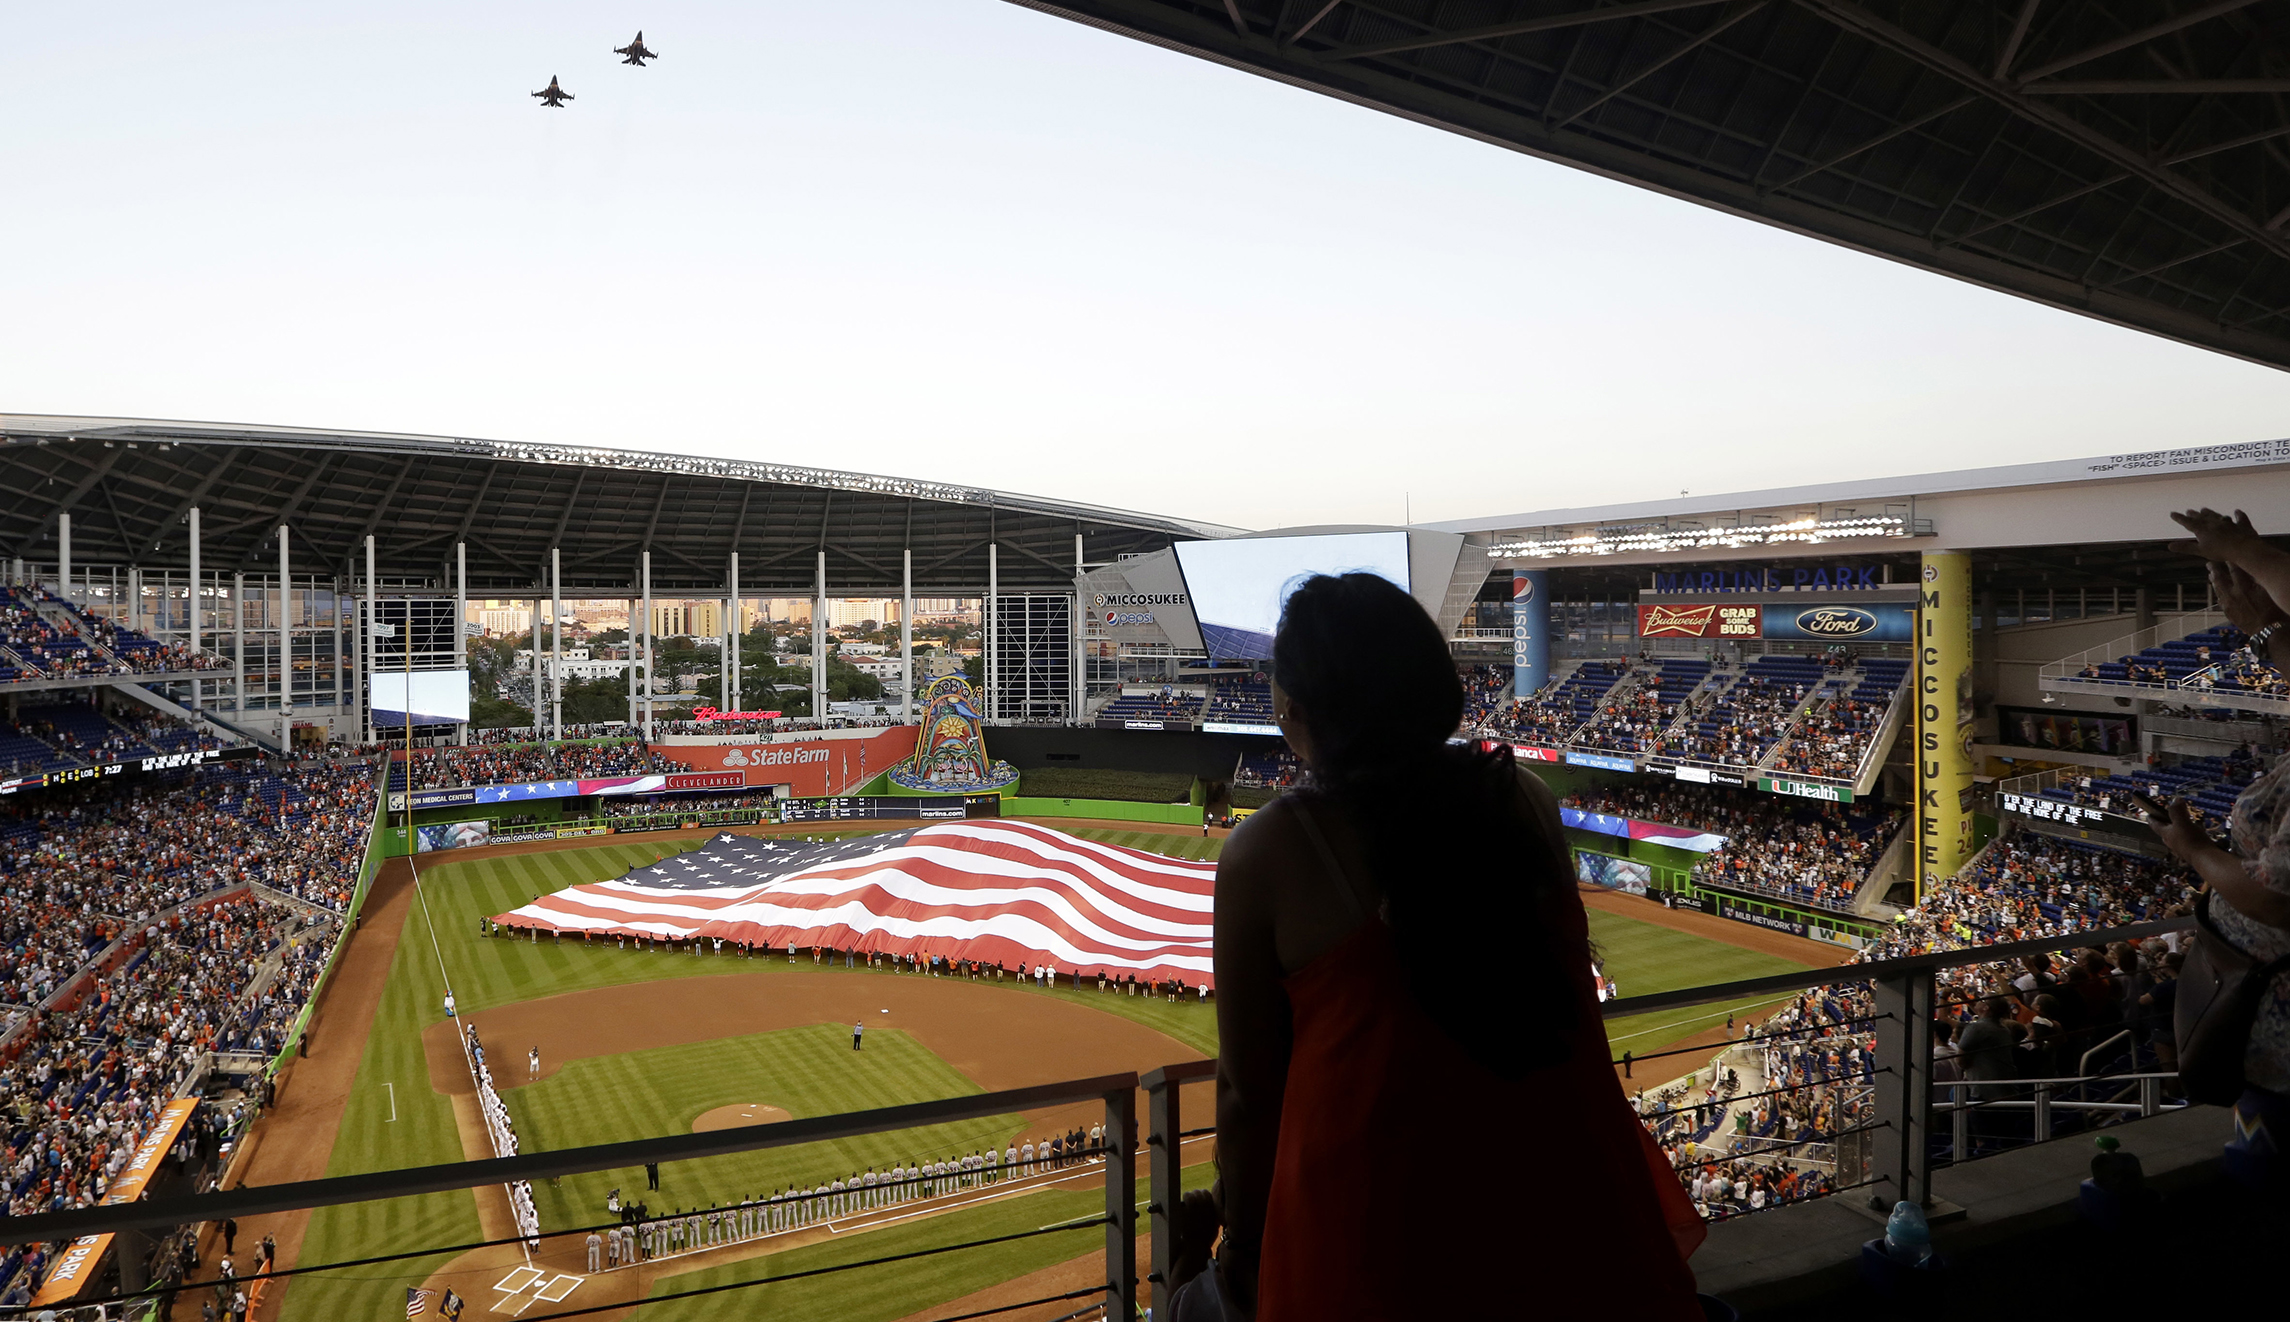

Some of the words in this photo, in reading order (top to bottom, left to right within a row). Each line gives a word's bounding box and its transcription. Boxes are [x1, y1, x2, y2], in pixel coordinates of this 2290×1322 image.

[2126, 452, 2167, 462] REPORT
[2170, 450, 2191, 458] FAN
[2194, 441, 2272, 456] MISCONDUCT:
[2122, 459, 2166, 470] <SPACE>
[2169, 456, 2199, 466] ISSUE
[2202, 455, 2209, 463] &
[2212, 449, 2271, 462] LOCATION
[1656, 568, 1781, 595] MARLINS
[1795, 565, 1879, 592] PARK
[1106, 594, 1185, 605] MICCOSUKEE
[1119, 612, 1153, 626] pepsi
[1644, 612, 1713, 628] Budweiser
[1720, 607, 1757, 619] GRAB
[1726, 617, 1749, 625] SOME
[1810, 611, 1860, 634] Ford
[1514, 607, 1531, 668] pepsi
[1720, 624, 1756, 636] BUDS
[692, 706, 783, 722] Budweiser
[1126, 721, 1162, 729] marlins.com
[1922, 590, 1940, 865] MICCOSUKEE
[206, 750, 220, 758] FREE
[67, 772, 73, 780] E
[80, 769, 94, 778] LOB
[104, 764, 122, 775] 7:27
[2, 779, 23, 788] DETROIT
[668, 776, 741, 788] CLEVELANDER
[2, 787, 17, 795] MIAMI
[422, 795, 447, 804] MEDICAL
[448, 793, 473, 802] CENTERS
[2004, 794, 2020, 805] O'ER
[2022, 797, 2035, 808] THE
[2037, 799, 2054, 811] LAND
[2056, 803, 2066, 813] OF
[2068, 806, 2082, 817] THE
[2084, 809, 2103, 821] FREE
[2004, 802, 2017, 811] AND
[2019, 804, 2032, 815] THE
[2033, 807, 2051, 819] HOME
[2052, 811, 2061, 820] OF
[2064, 813, 2078, 824] THE
[491, 835, 511, 843] GOYA
[513, 833, 533, 841] GOYA
[1735, 910, 1751, 922] MLB
[1752, 914, 1791, 931] NETWORK
[144, 1109, 184, 1147] MARLINS
[126, 1147, 157, 1172] PARK
[50, 1247, 92, 1283] PARK
